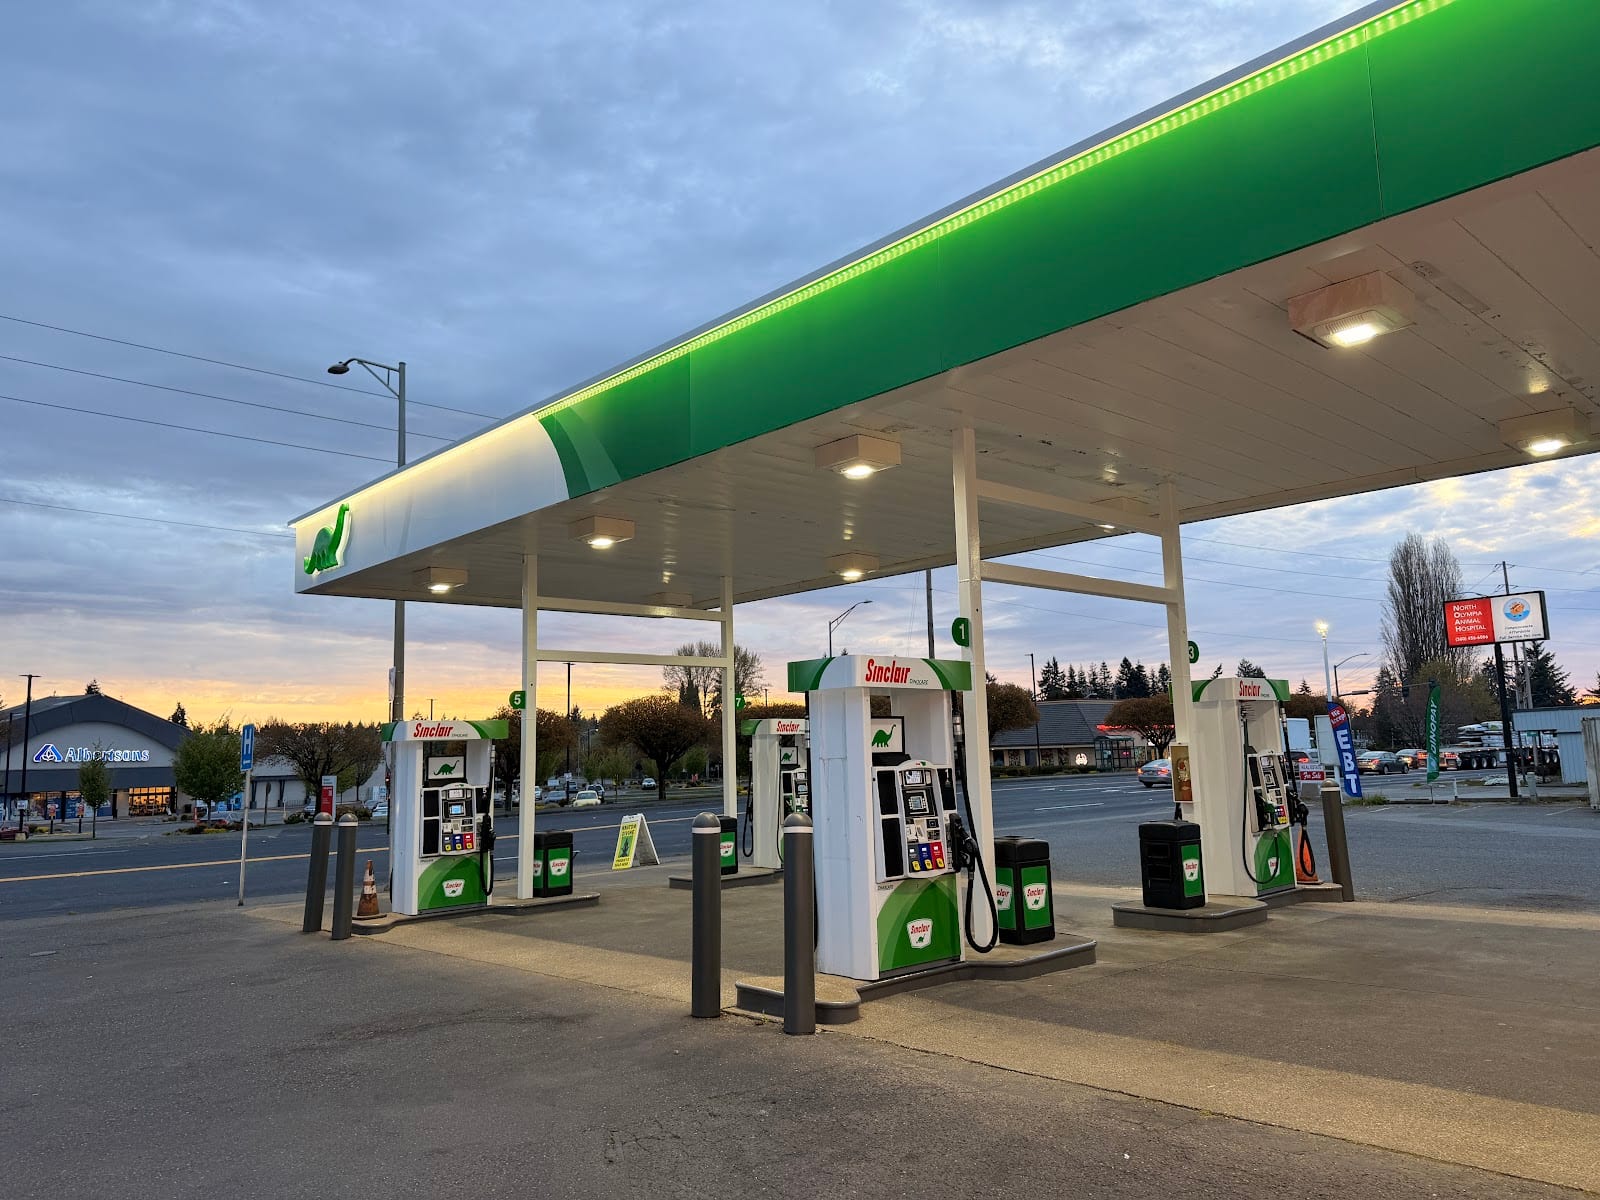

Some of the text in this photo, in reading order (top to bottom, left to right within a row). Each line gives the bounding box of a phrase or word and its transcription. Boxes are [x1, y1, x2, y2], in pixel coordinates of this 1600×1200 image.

[1453, 604, 1477, 612] NORTH
[1453, 610, 1483, 618] OLYMPIA
[959, 623, 965, 640] 1
[1188, 645, 1195, 659] 3
[865, 658, 911, 684] Sinclair
[1239, 680, 1261, 697] Sinclair
[513, 693, 521, 705] 5
[735, 697, 742, 707] 7
[1331, 709, 1341, 717] We
[413, 722, 454, 738] Sinclair
[776, 721, 800, 733] Sinclair
[243, 728, 252, 756] H
[64, 746, 150, 763] Albertsons
[1336, 729, 1358, 794] EBT
[1311, 771, 1322, 779] Sale
[551, 860, 567, 868] Sinclair
[445, 880, 463, 890] Sinclair
[996, 888, 1010, 898] clair
[1026, 887, 1044, 898] Sinclair
[910, 923, 931, 935] Sinclair
